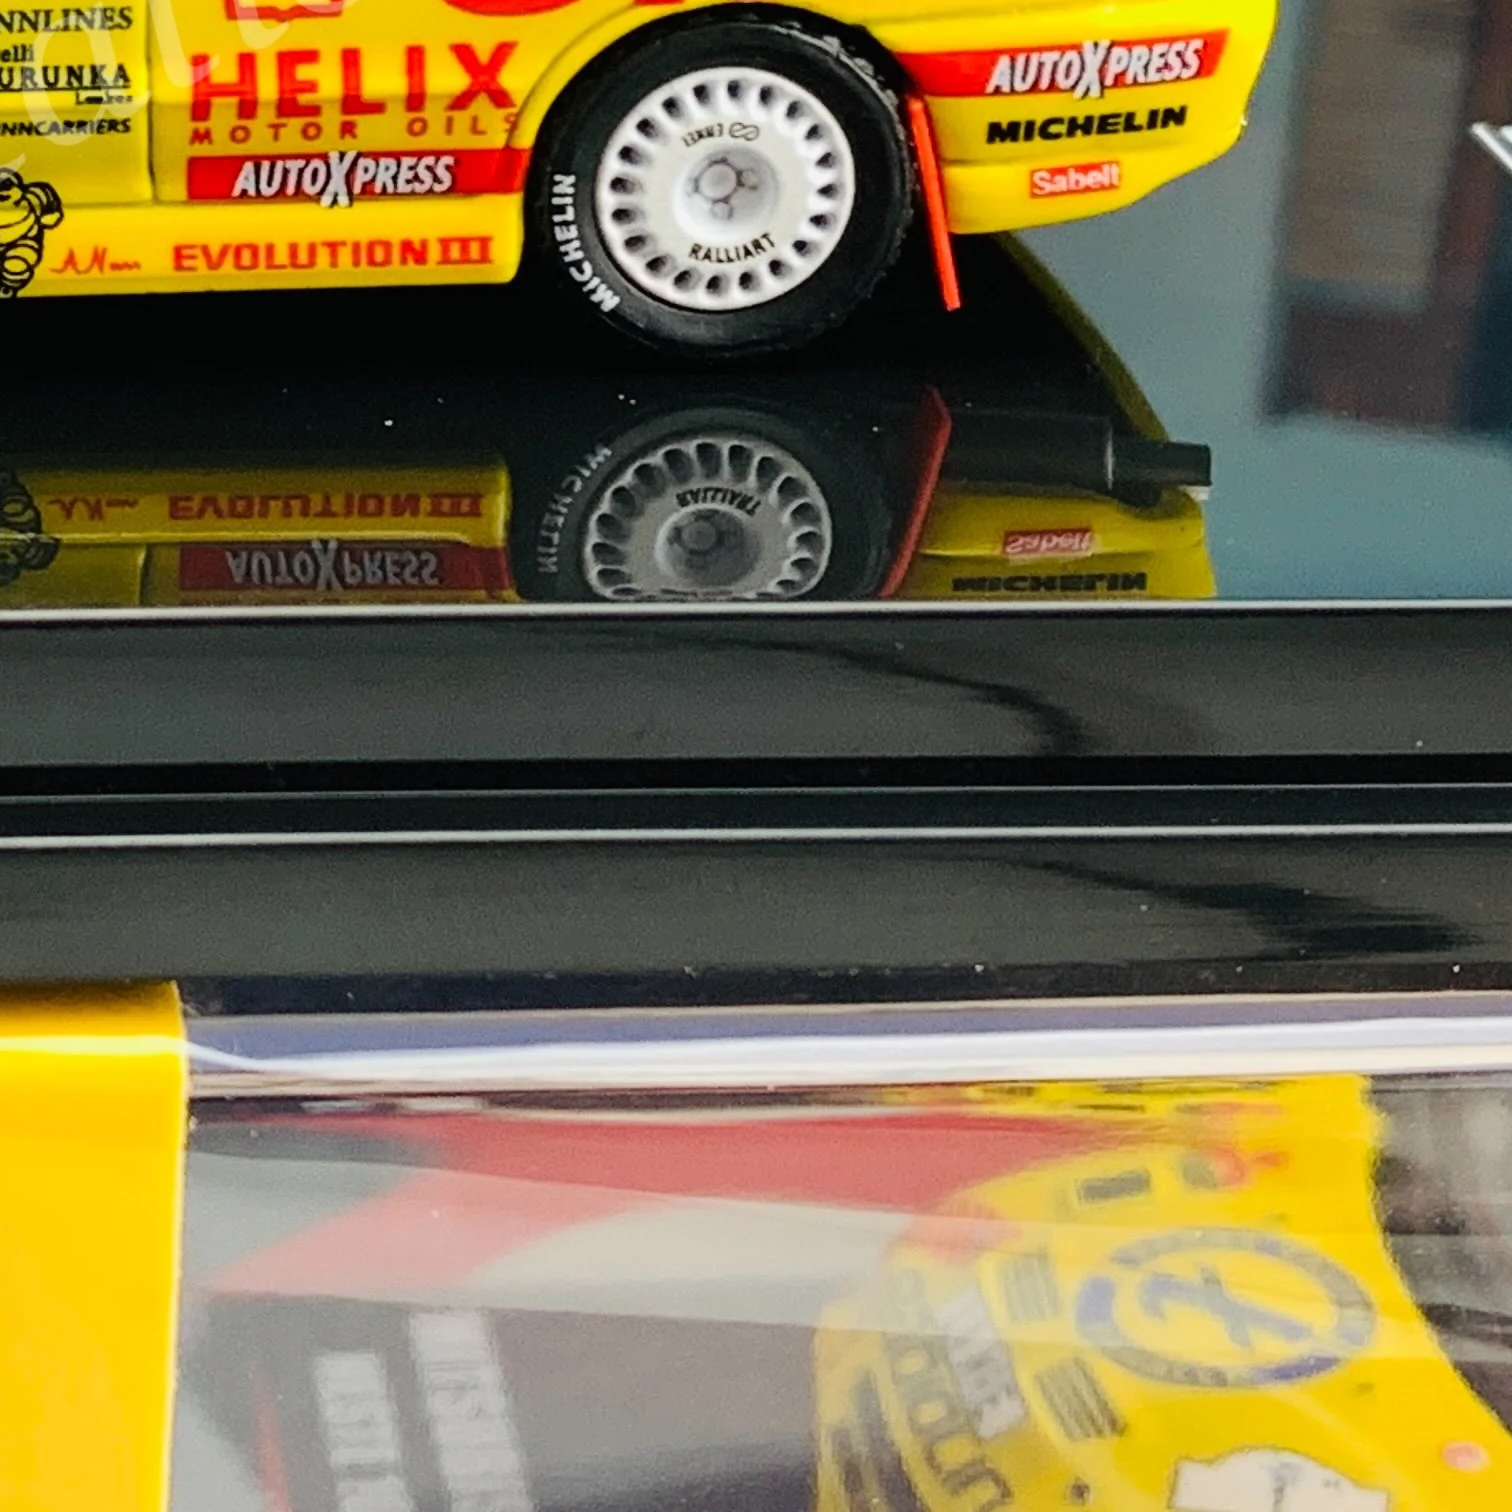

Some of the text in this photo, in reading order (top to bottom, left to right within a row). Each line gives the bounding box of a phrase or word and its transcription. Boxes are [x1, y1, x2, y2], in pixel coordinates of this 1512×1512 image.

[191, 41, 519, 123] HELIX
[985, 38, 1205, 100] AUTOXPRESS
[189, 113, 519, 146] MOTOR OILS
[985, 105, 1188, 144] MICHELIN
[231, 150, 455, 208] AUTOXPRESS
[1032, 163, 1120, 195] Sabelt
[173, 238, 429, 273] EVOLUTION
[436, 235, 494, 266] III
[550, 173, 621, 313] MICHELIN
[687, 232, 777, 263] RALLIART
